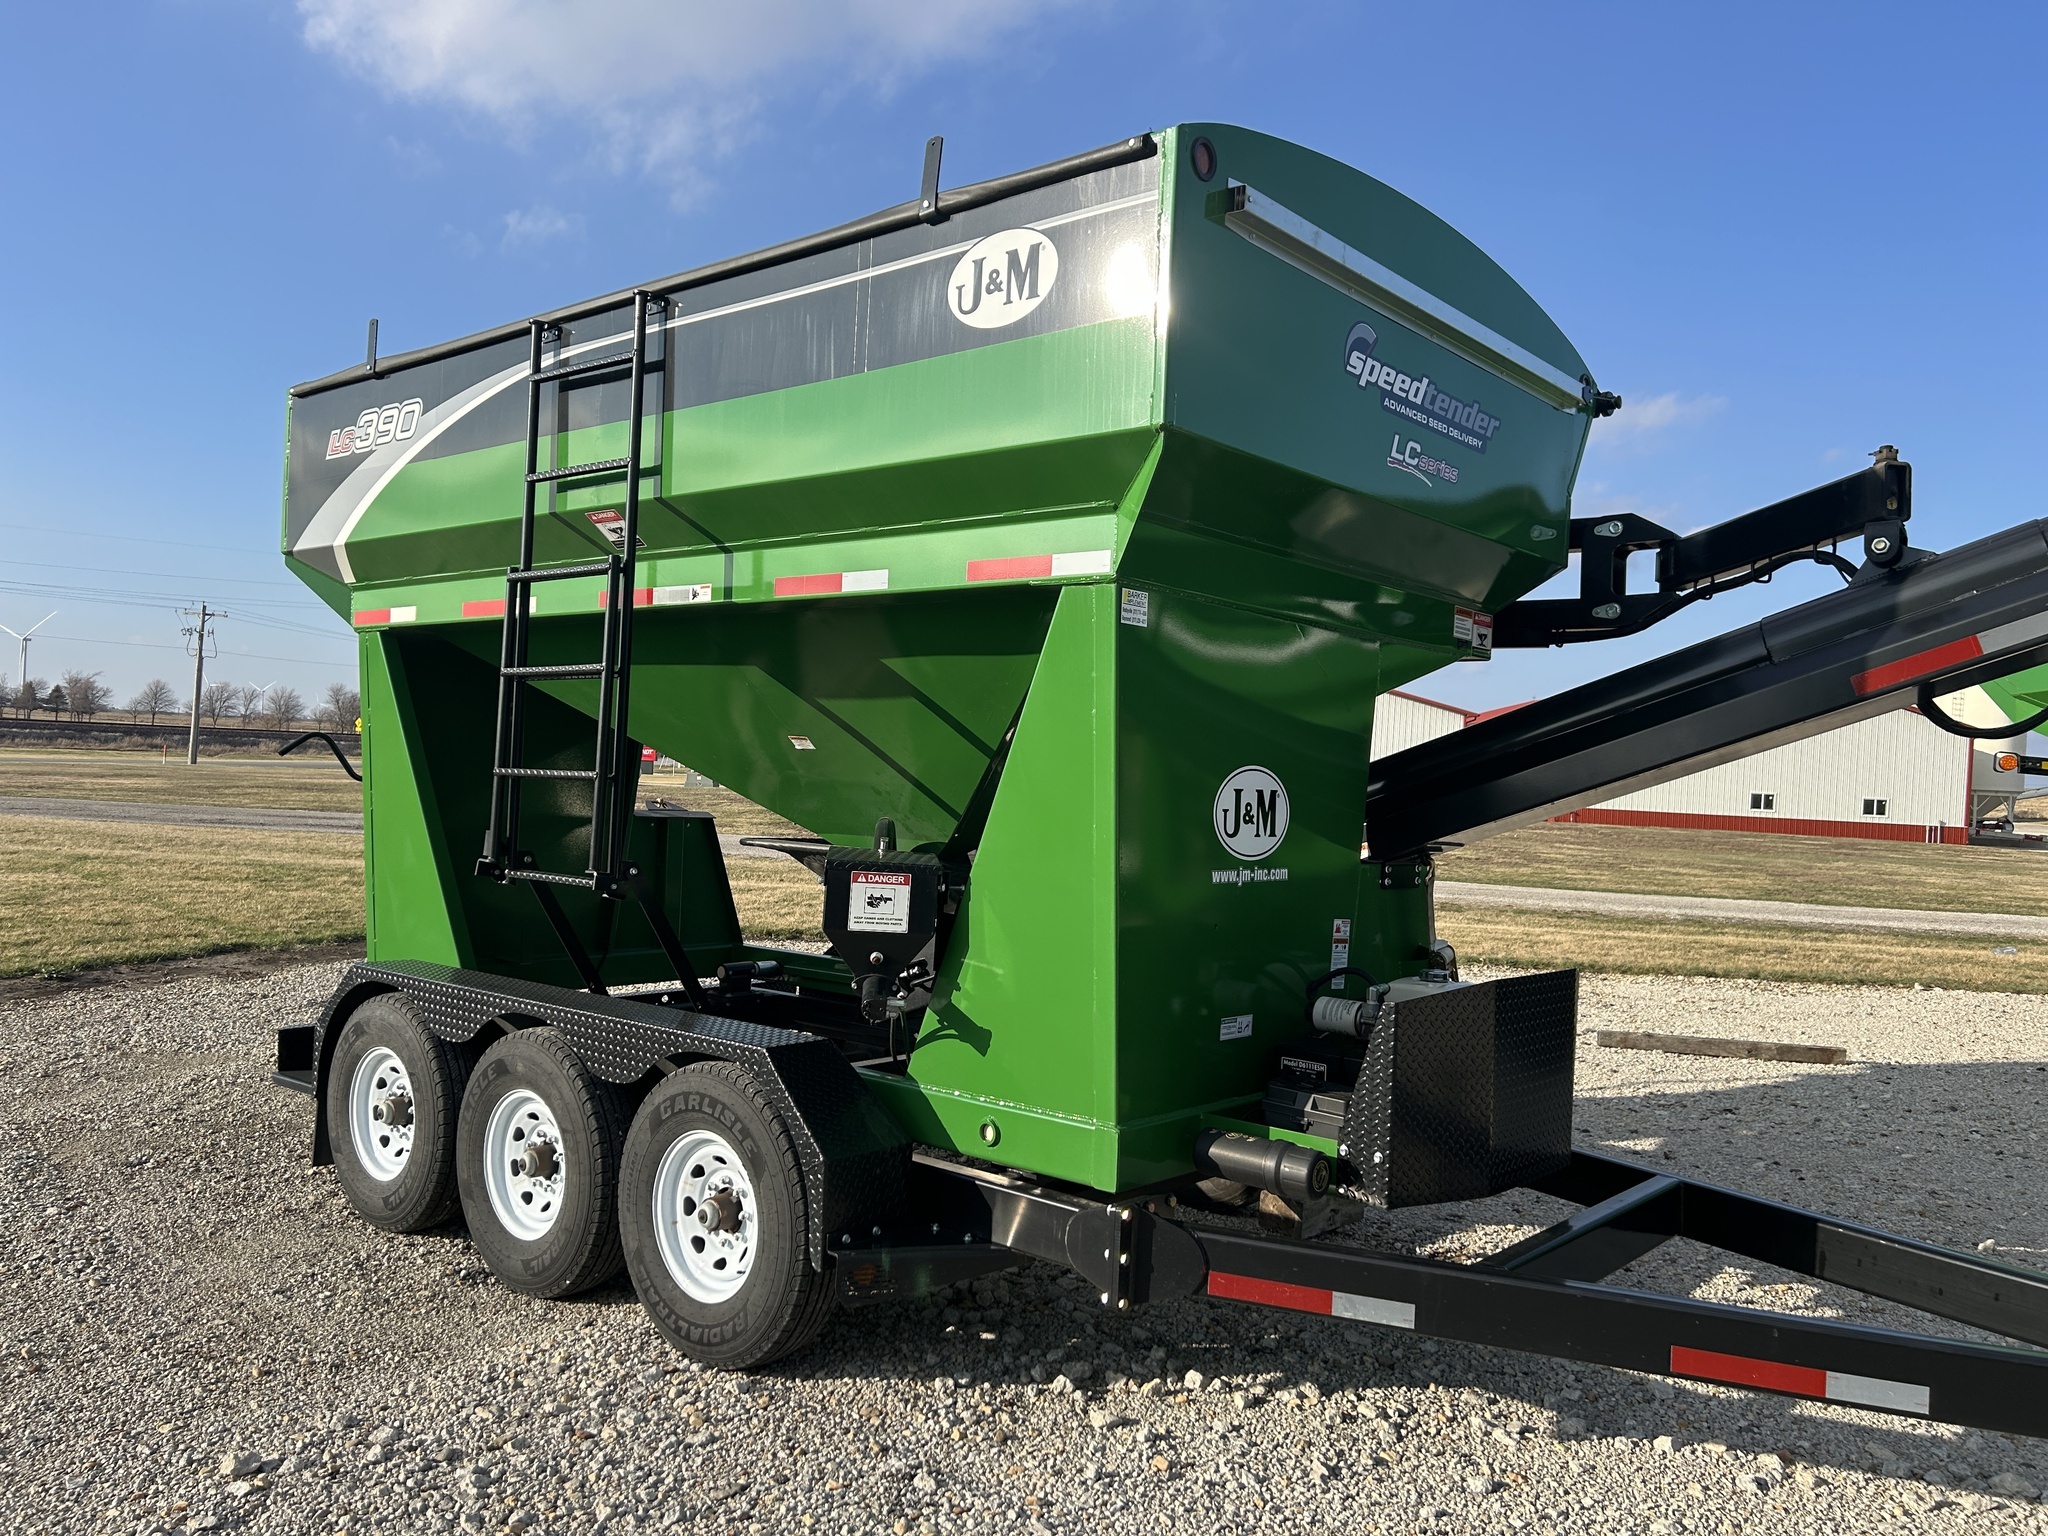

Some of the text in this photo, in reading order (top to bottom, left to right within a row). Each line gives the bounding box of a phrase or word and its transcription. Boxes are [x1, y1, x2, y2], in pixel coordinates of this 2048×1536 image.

[956, 241, 1043, 316] J&M
[1383, 398, 1483, 449] ADVANCED SEED DELIVERY
[1127, 590, 1148, 601] BARKER
[1222, 788, 1279, 839] J&M
[867, 874, 905, 884] DANGER
[1211, 866, 1288, 886] www.jm-inc.com
[660, 1094, 757, 1158] CARLISLE
